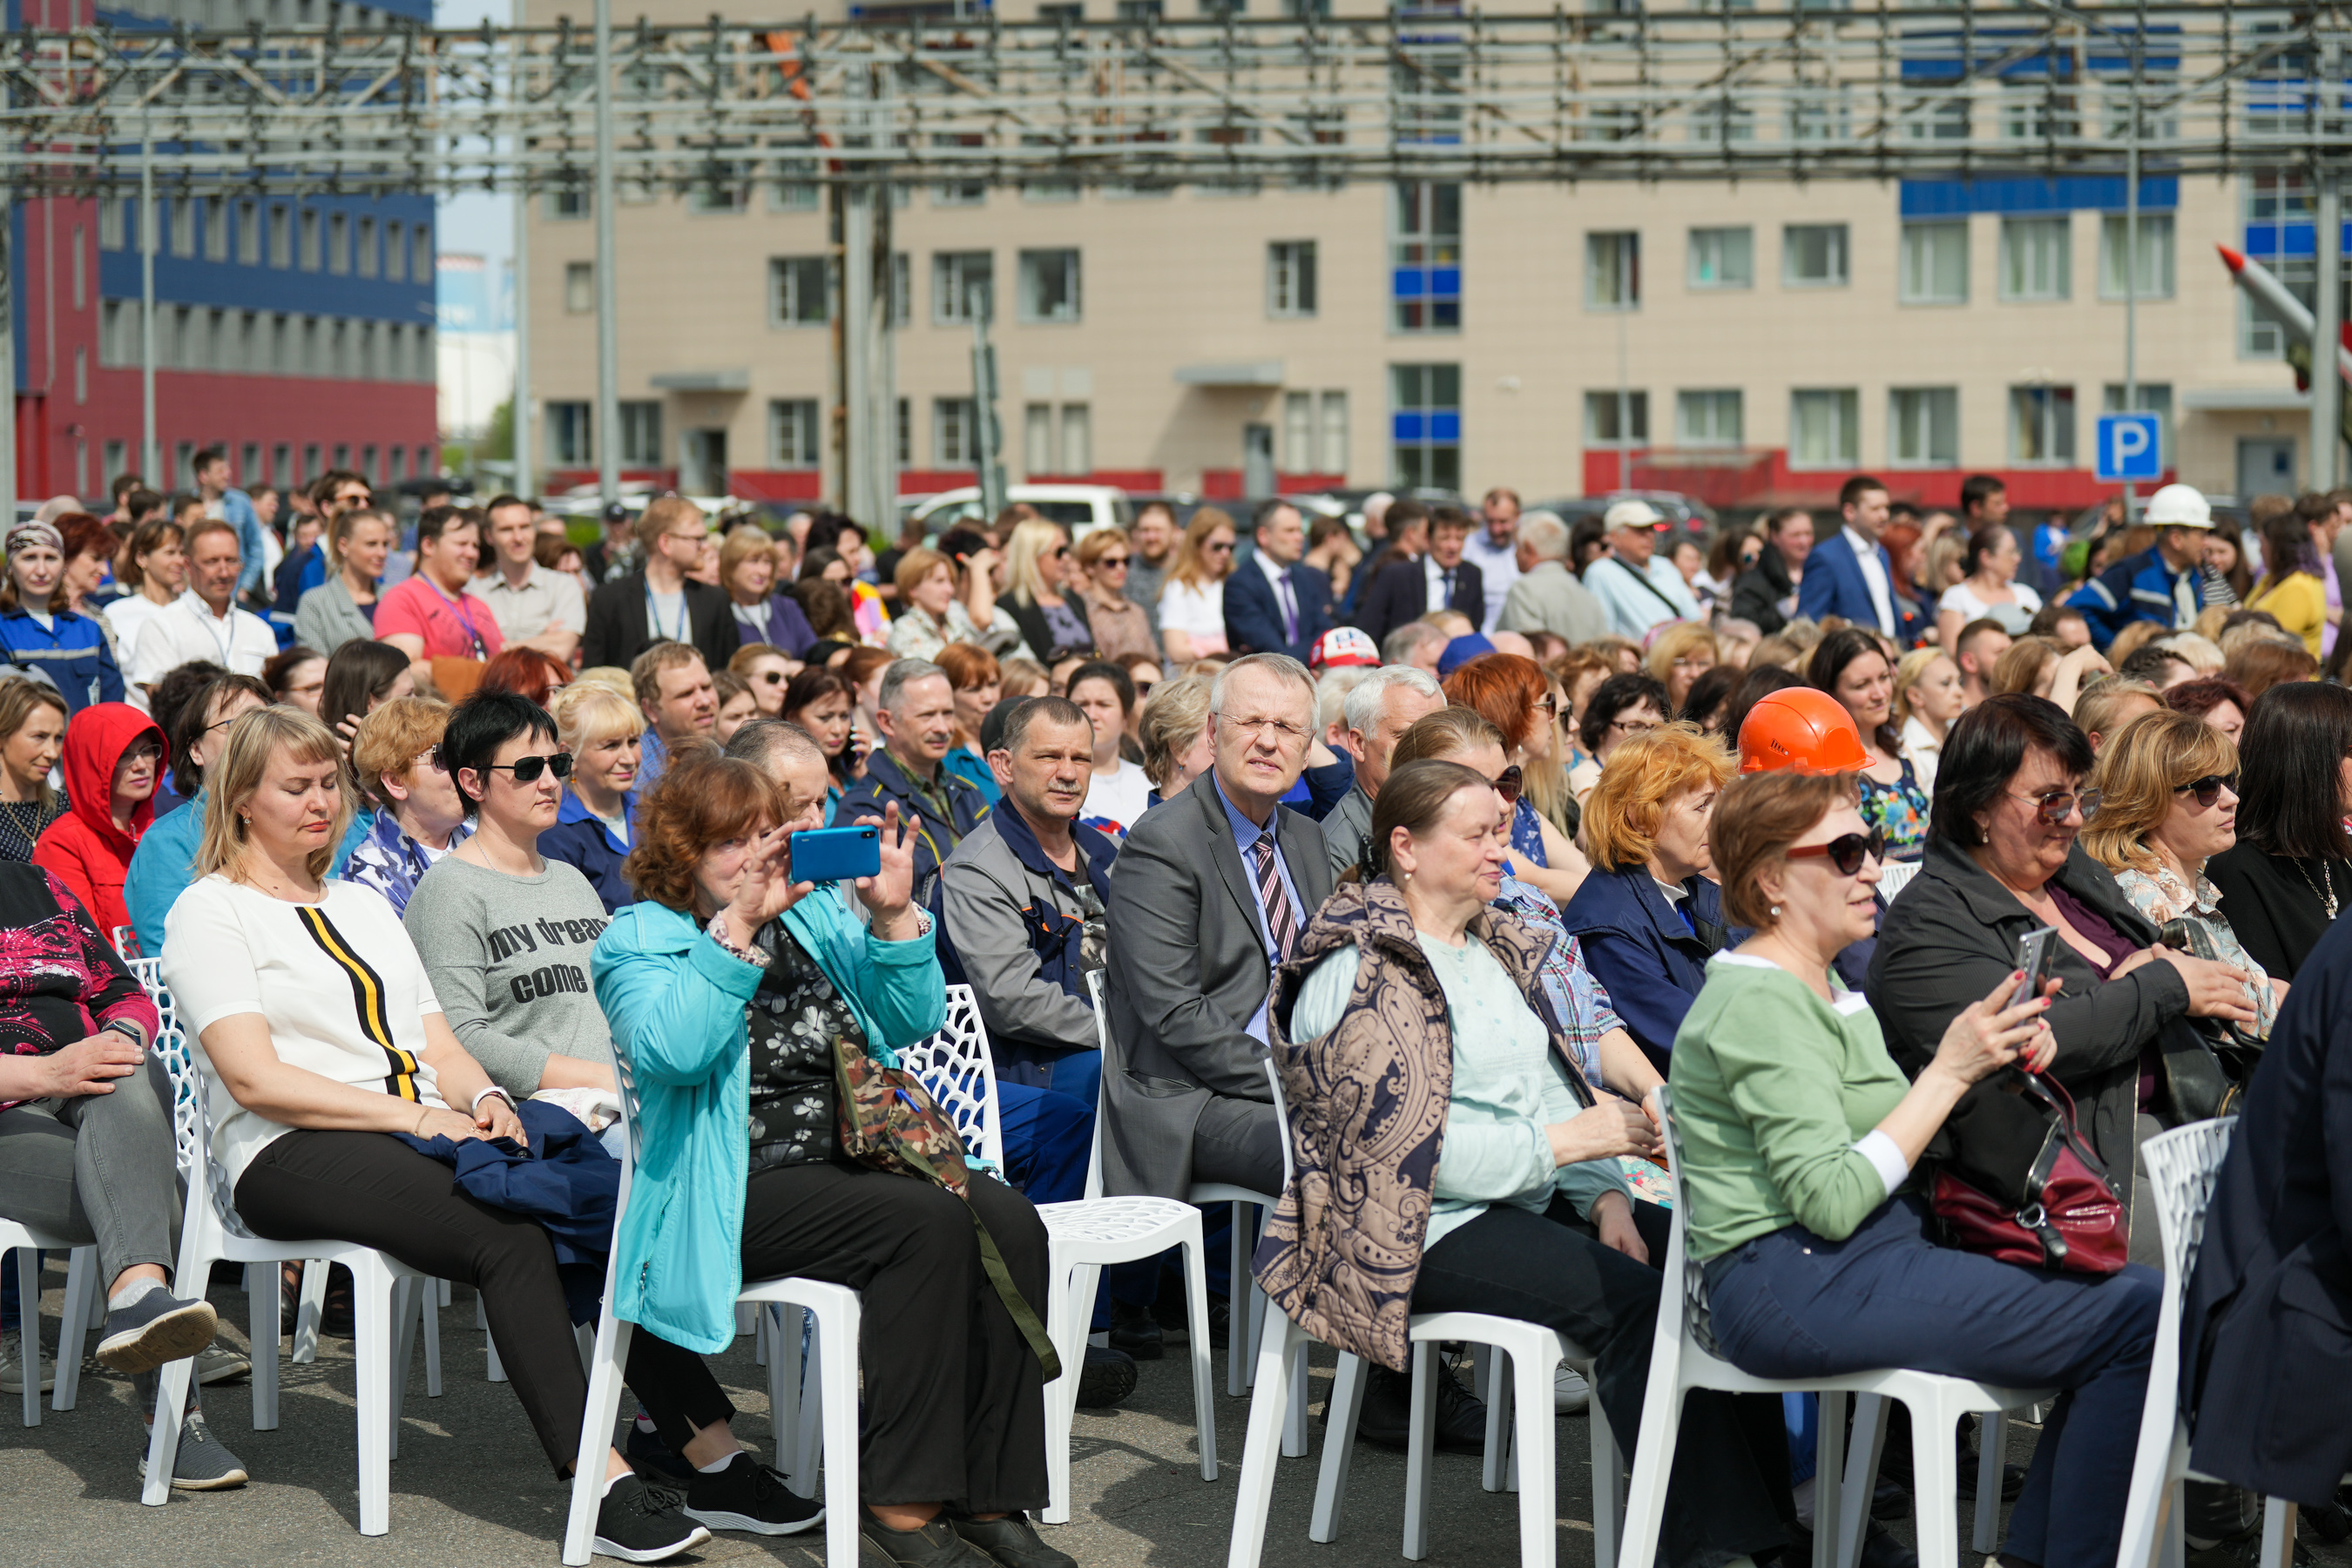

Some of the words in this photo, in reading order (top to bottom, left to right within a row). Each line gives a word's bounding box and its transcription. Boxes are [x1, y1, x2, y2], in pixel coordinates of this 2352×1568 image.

[2112, 422, 2149, 473] P
[487, 923, 537, 963] my
[510, 963, 589, 1004] come
